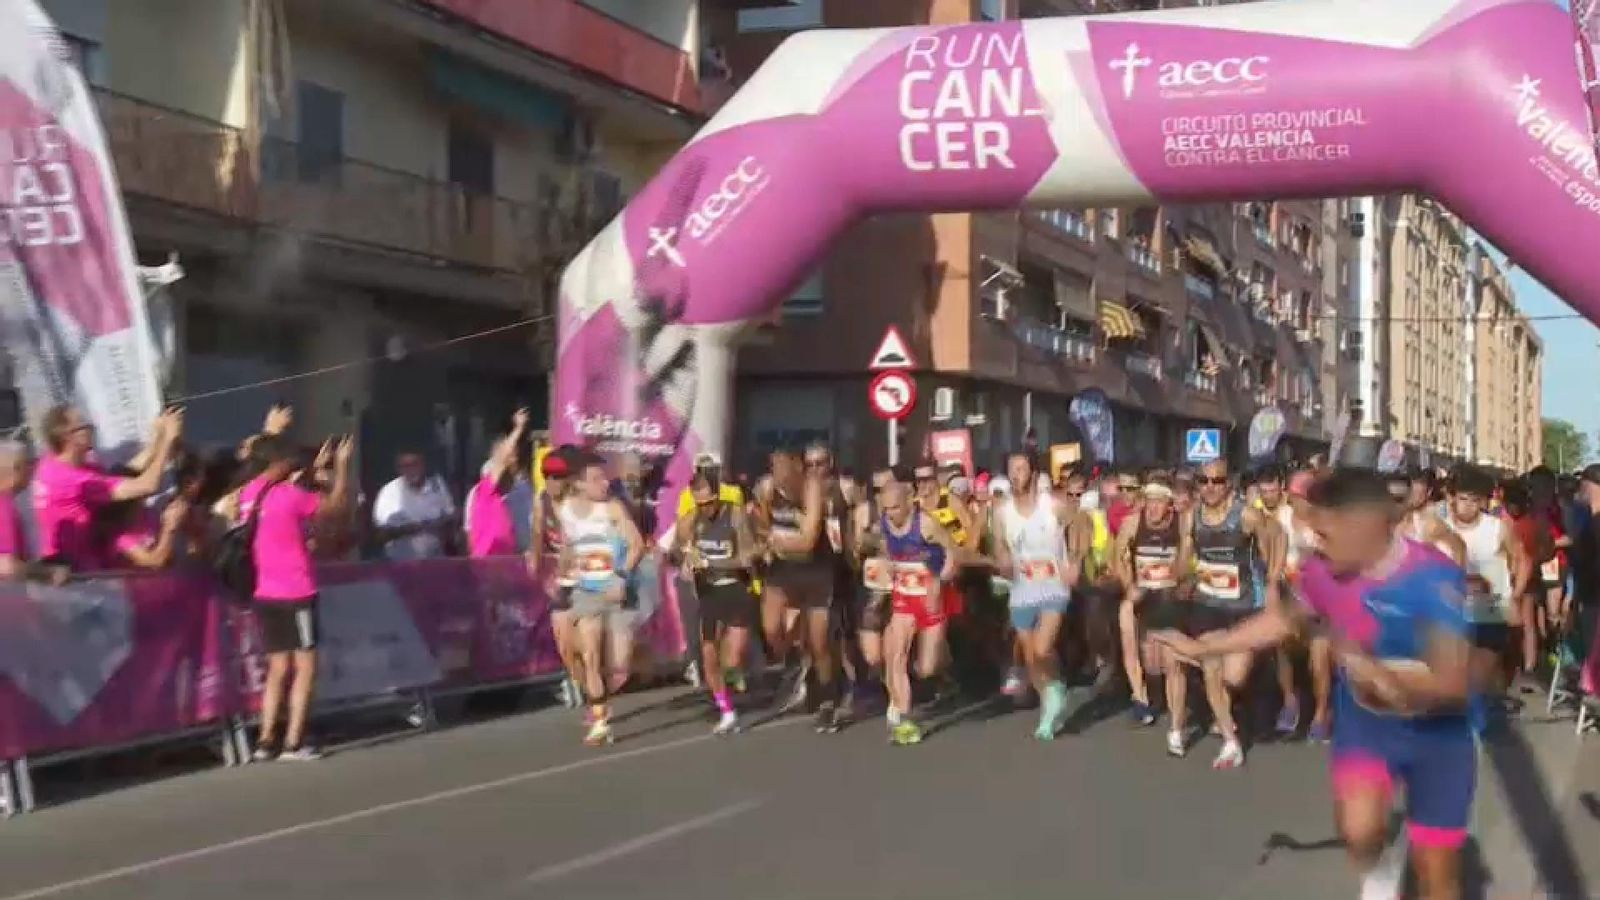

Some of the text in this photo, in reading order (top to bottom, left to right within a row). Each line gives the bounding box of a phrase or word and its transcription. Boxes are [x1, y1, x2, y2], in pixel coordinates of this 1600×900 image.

[904, 33, 1024, 69] RUN
[1158, 55, 1270, 87] aecc
[1161, 107, 1367, 135] CIRCUITO PROVINCIAL
[898, 121, 1015, 171] CER
[1164, 129, 1315, 151] AECC VALENCIA
[1165, 149, 1241, 167] CONTRA
[1246, 147, 1271, 164] EL
[684, 156, 764, 239] aecc
